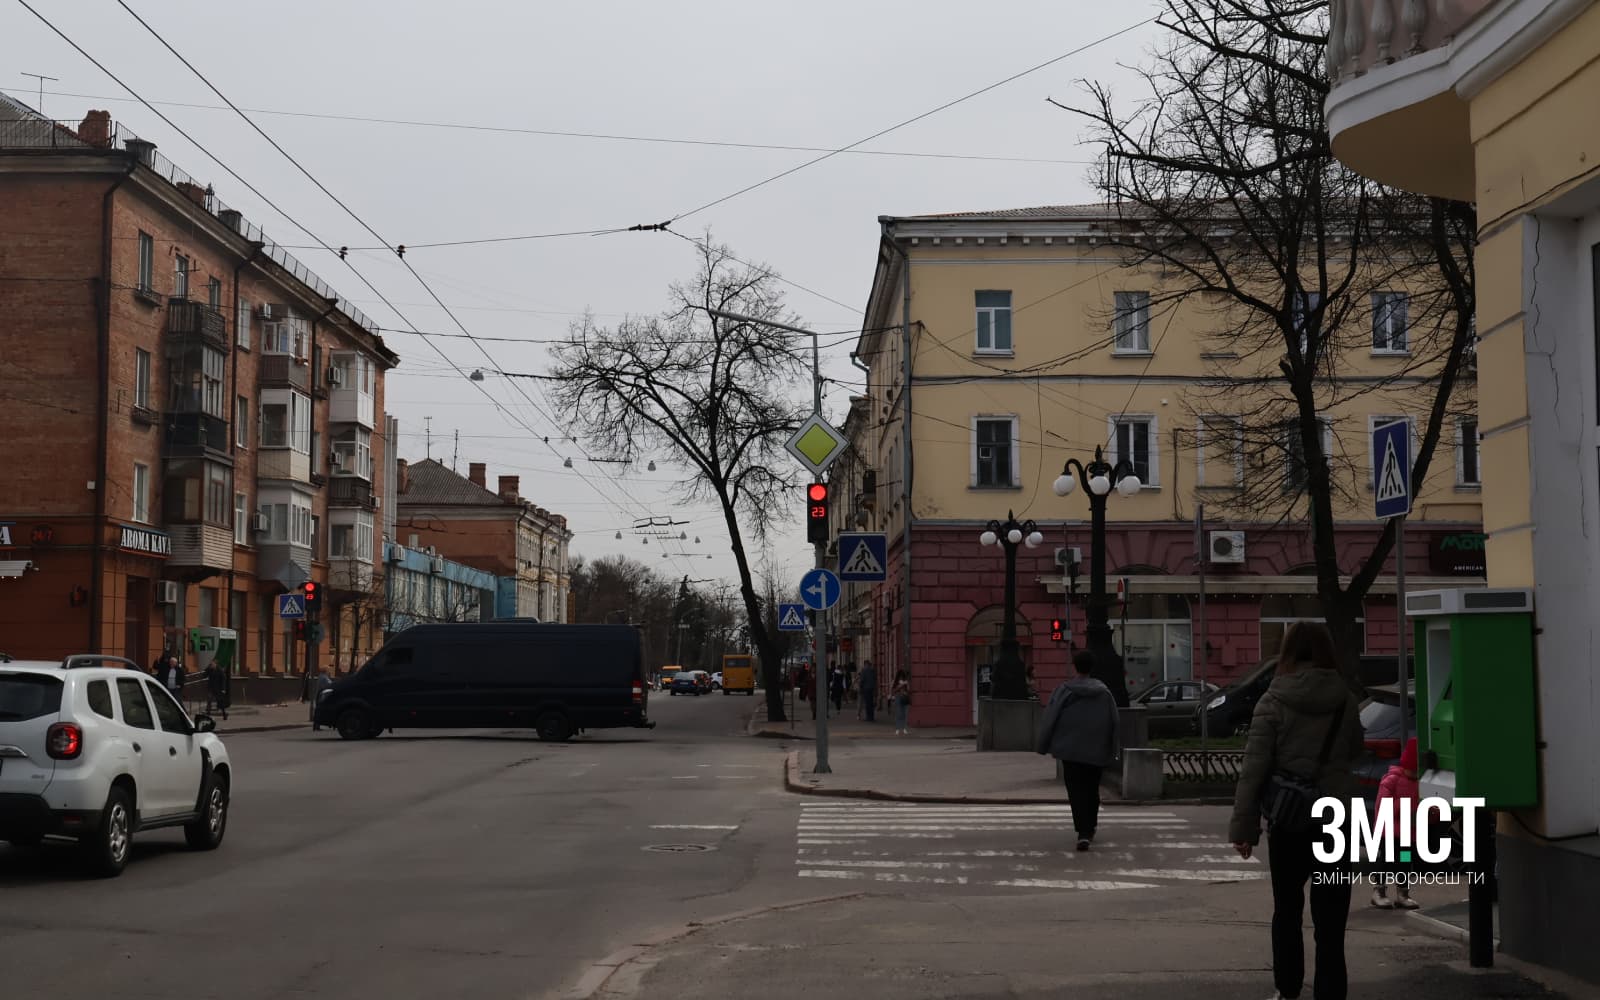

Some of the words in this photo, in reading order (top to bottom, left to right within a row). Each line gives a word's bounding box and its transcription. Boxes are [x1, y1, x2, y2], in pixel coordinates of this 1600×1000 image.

[811, 506, 825, 517] 23
[120, 527, 150, 551] AROMA
[151, 533, 172, 555] KAVA
